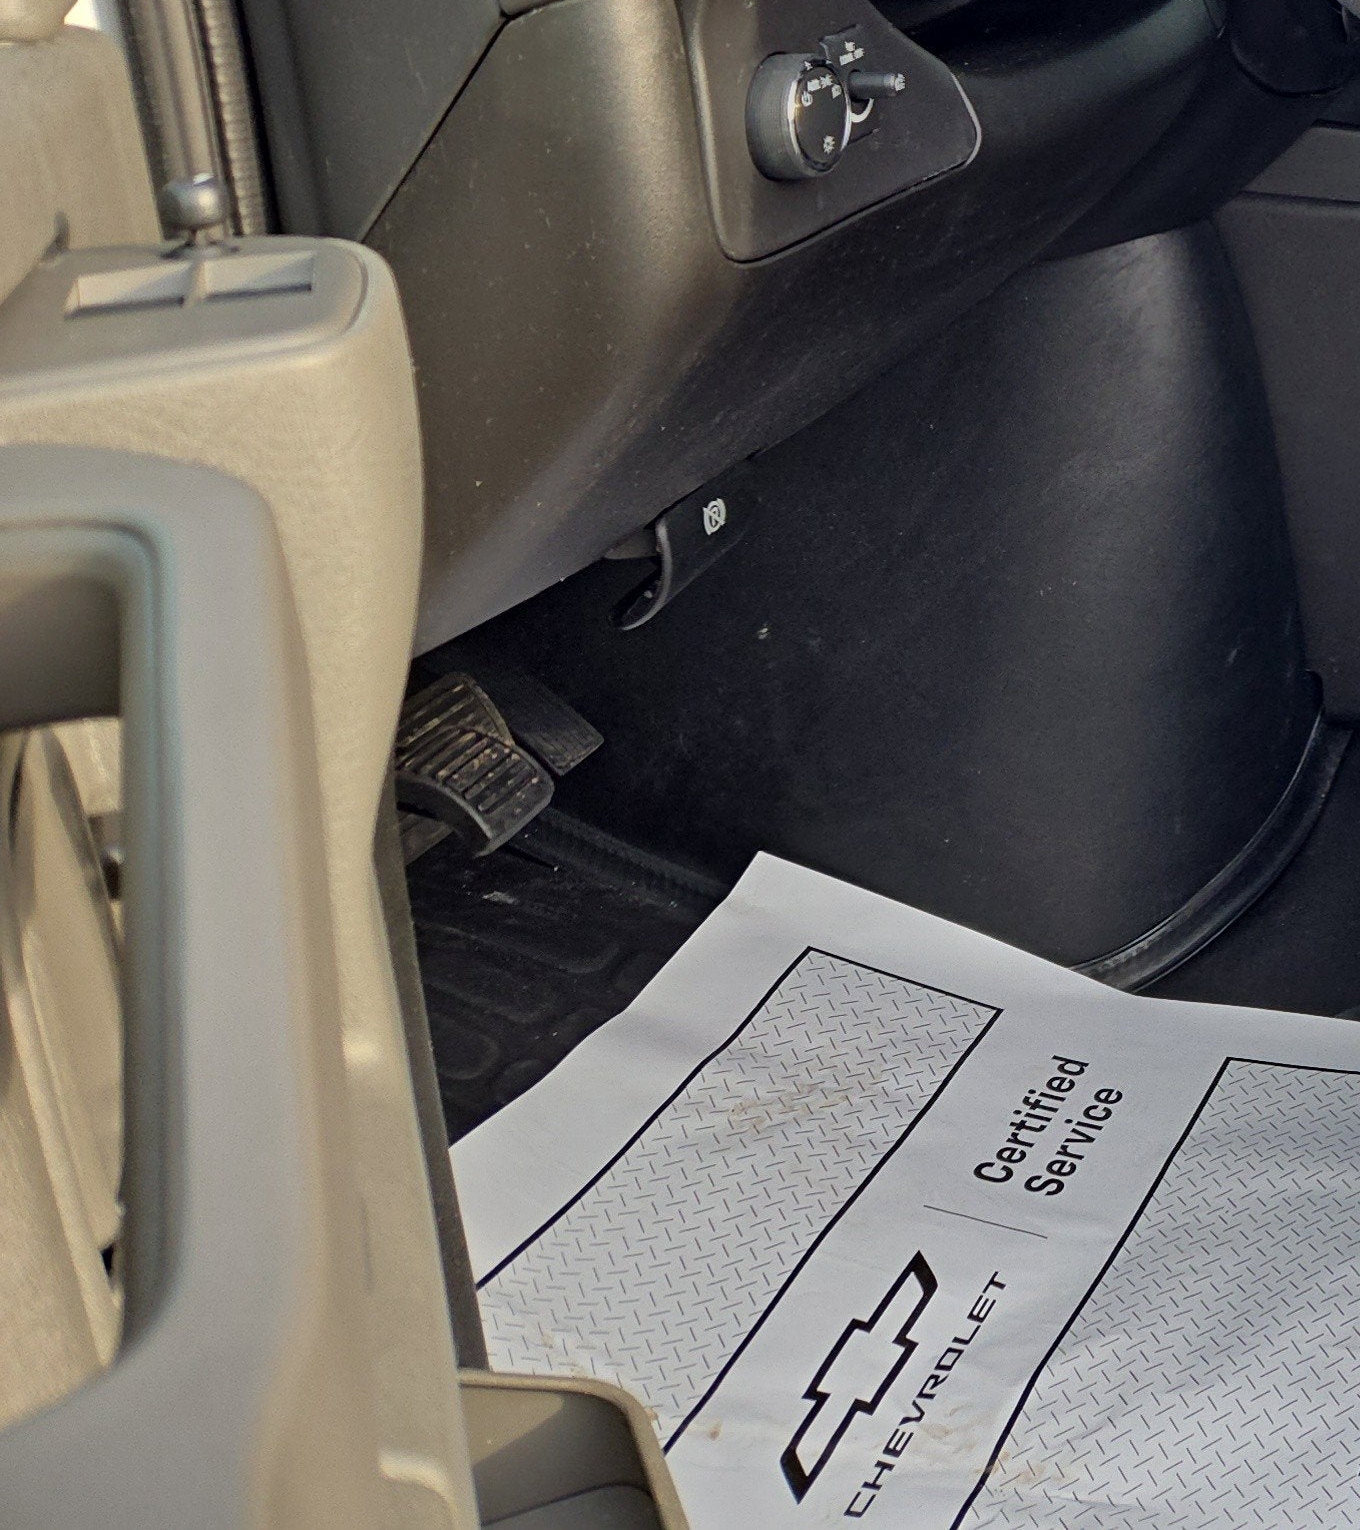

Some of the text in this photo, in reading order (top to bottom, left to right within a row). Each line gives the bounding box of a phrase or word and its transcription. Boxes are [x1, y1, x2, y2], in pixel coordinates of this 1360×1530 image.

[973, 1055, 1089, 1183] Certified
[1024, 1088, 1123, 1196] Service
[843, 1271, 1006, 1518] CHEVROLET
